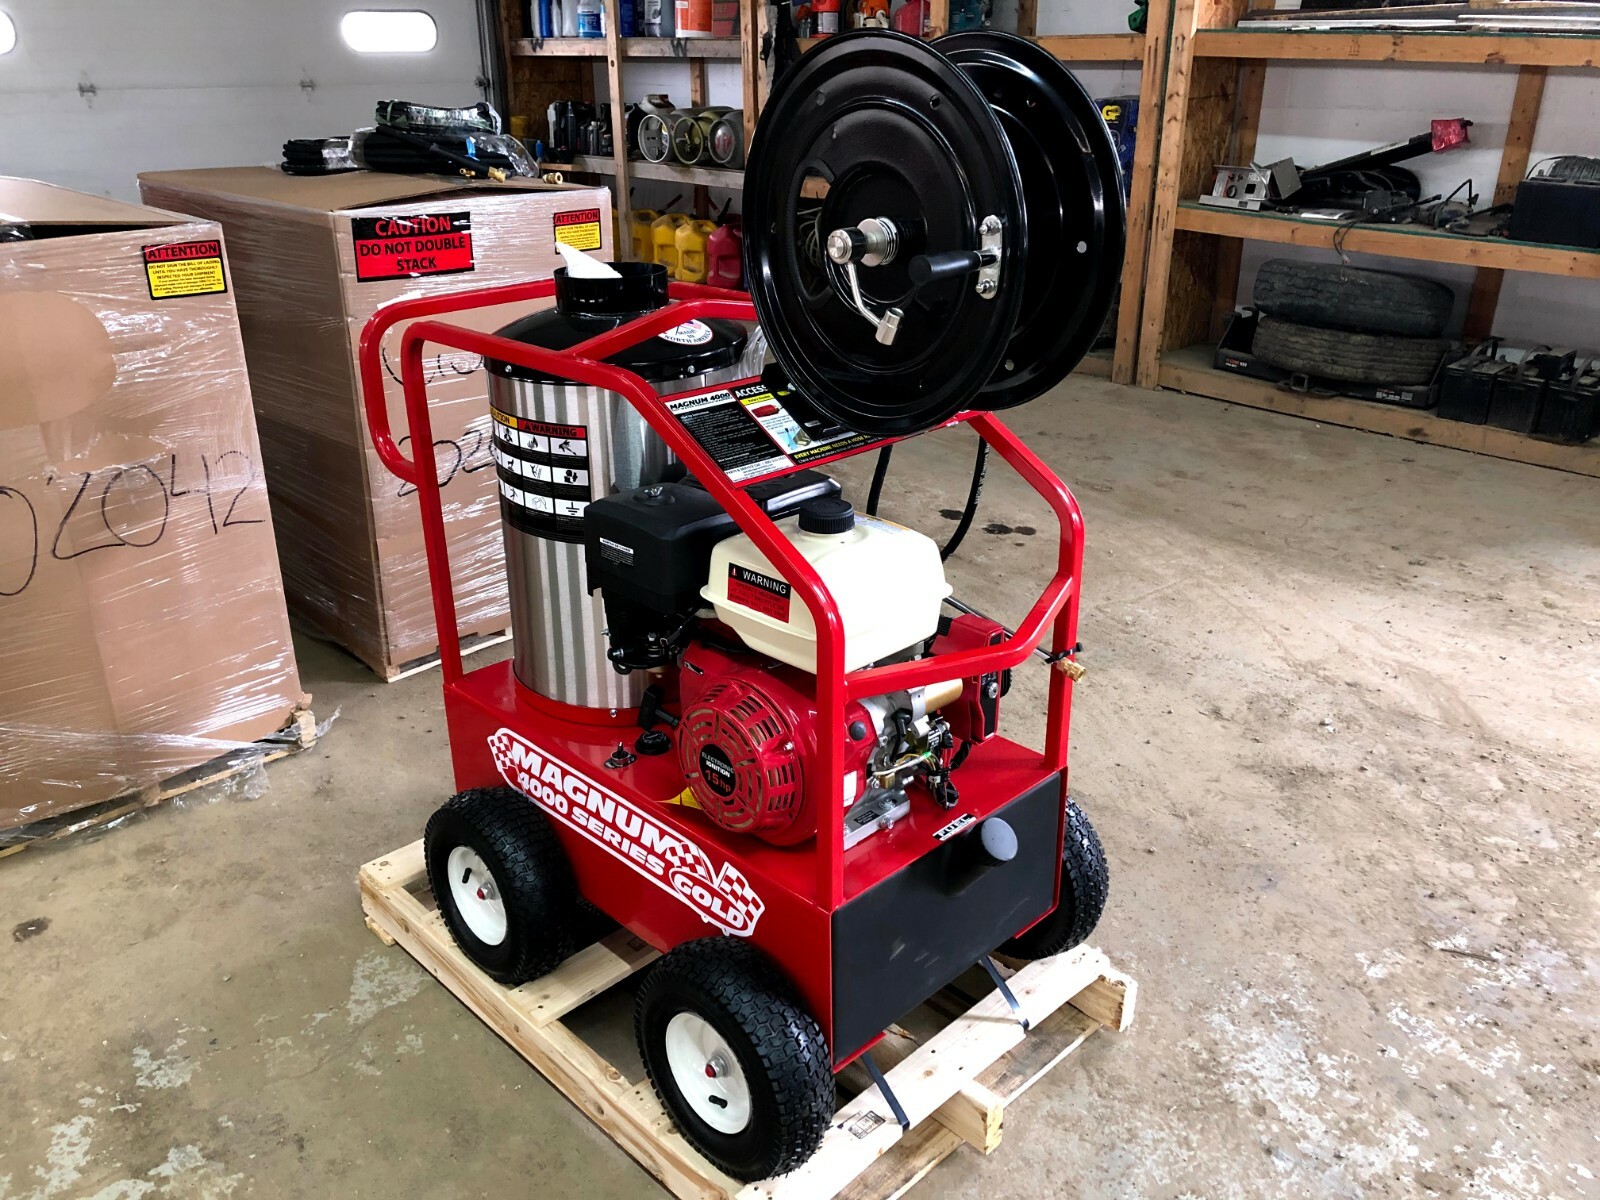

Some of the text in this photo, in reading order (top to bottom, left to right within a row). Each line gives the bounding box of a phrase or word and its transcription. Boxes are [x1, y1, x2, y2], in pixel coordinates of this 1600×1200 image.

[375, 216, 451, 236] CAUTION
[556, 211, 598, 223] ATTENTION
[148, 244, 217, 259] ATTENTION
[360, 236, 466, 256] DO NOT DOUBLE
[397, 257, 437, 271] STACK
[670, 392, 731, 410] MAGNUM 4000
[532, 425, 577, 437] WARNING
[794, 451, 809, 459] EVERY
[810, 444, 832, 455] MACHINE
[832, 440, 847, 449] NEEDS
[743, 570, 786, 594] WARNING
[702, 752, 734, 773] ELECTRONIC
[706, 760, 730, 777] IGNITION
[511, 741, 679, 860] MAGNUM
[517, 773, 666, 876] 4000 SERIES
[674, 873, 744, 927] GOLD
